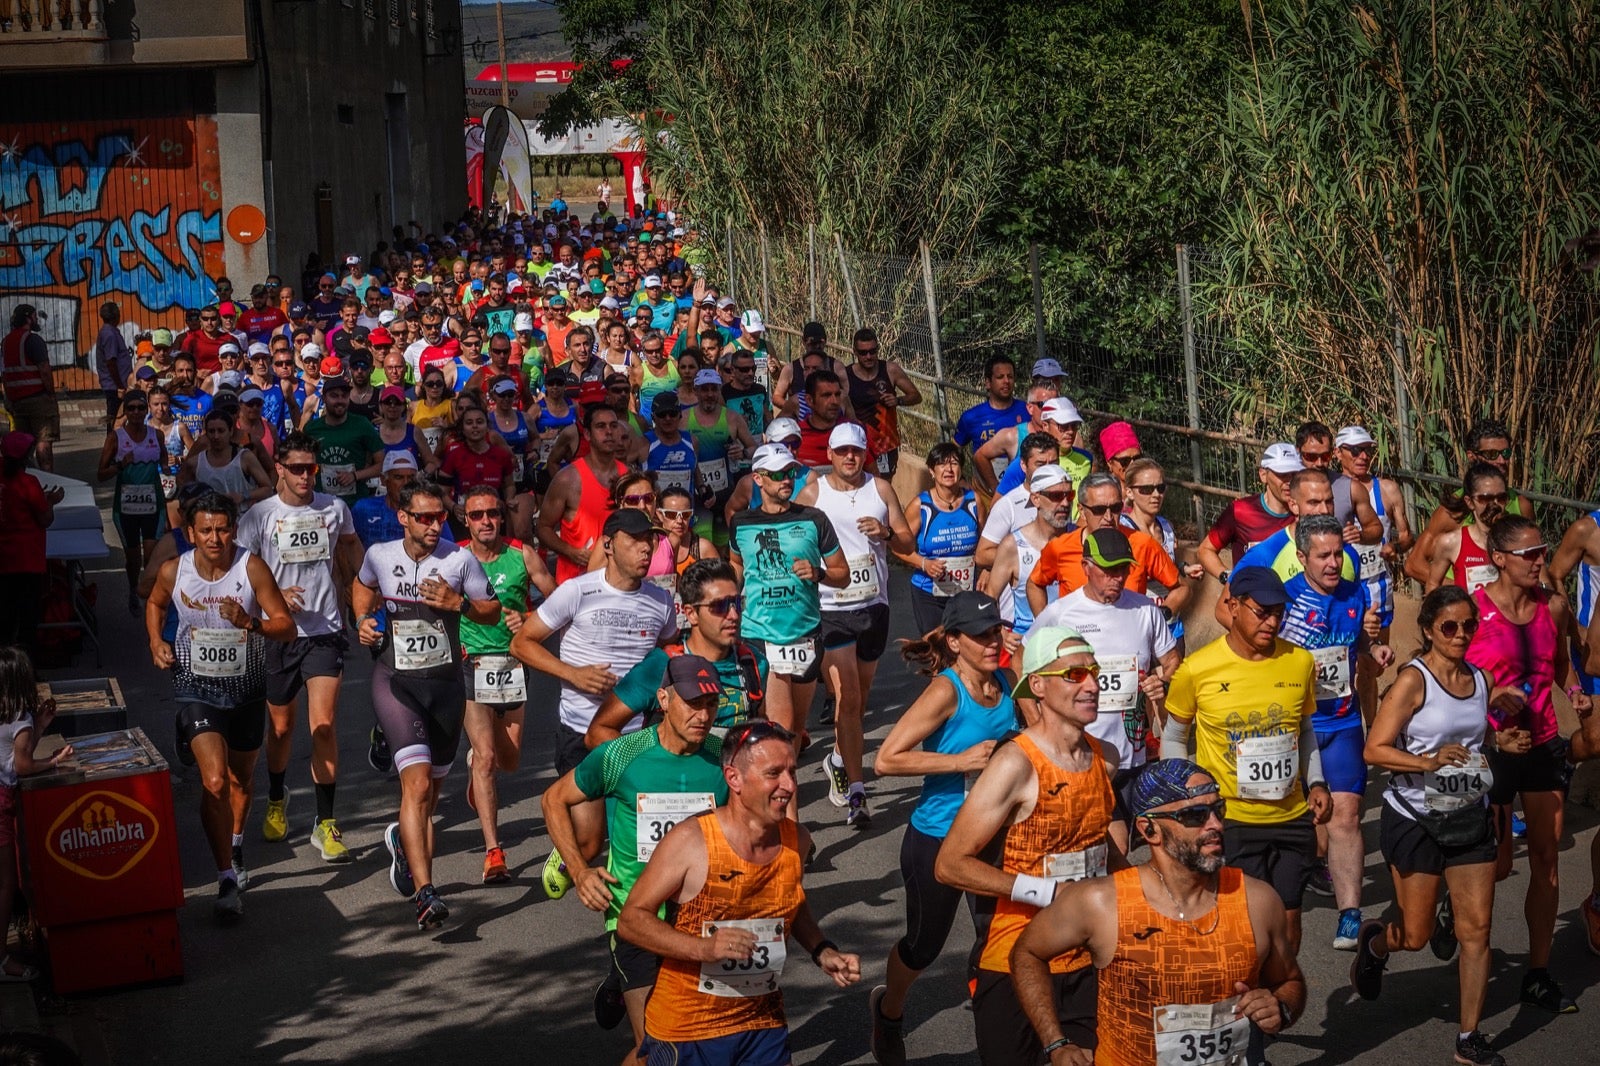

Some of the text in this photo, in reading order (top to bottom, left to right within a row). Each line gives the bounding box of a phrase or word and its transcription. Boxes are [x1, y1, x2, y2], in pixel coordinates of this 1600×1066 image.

[290, 530, 319, 548] 269
[1360, 550, 1376, 565] 65
[850, 568, 870, 584] 30
[761, 585, 796, 599] HSN
[406, 635, 438, 653] 270
[199, 646, 237, 662] 3088
[779, 646, 807, 662] 110
[486, 670, 513, 686] 672
[1317, 664, 1340, 682] 42
[1098, 673, 1122, 692] 35
[1249, 757, 1292, 781] 3015
[1435, 772, 1483, 793] 3014
[59, 819, 145, 854] Alhambra
[650, 820, 677, 842] 30
[1180, 1027, 1233, 1062] 355
